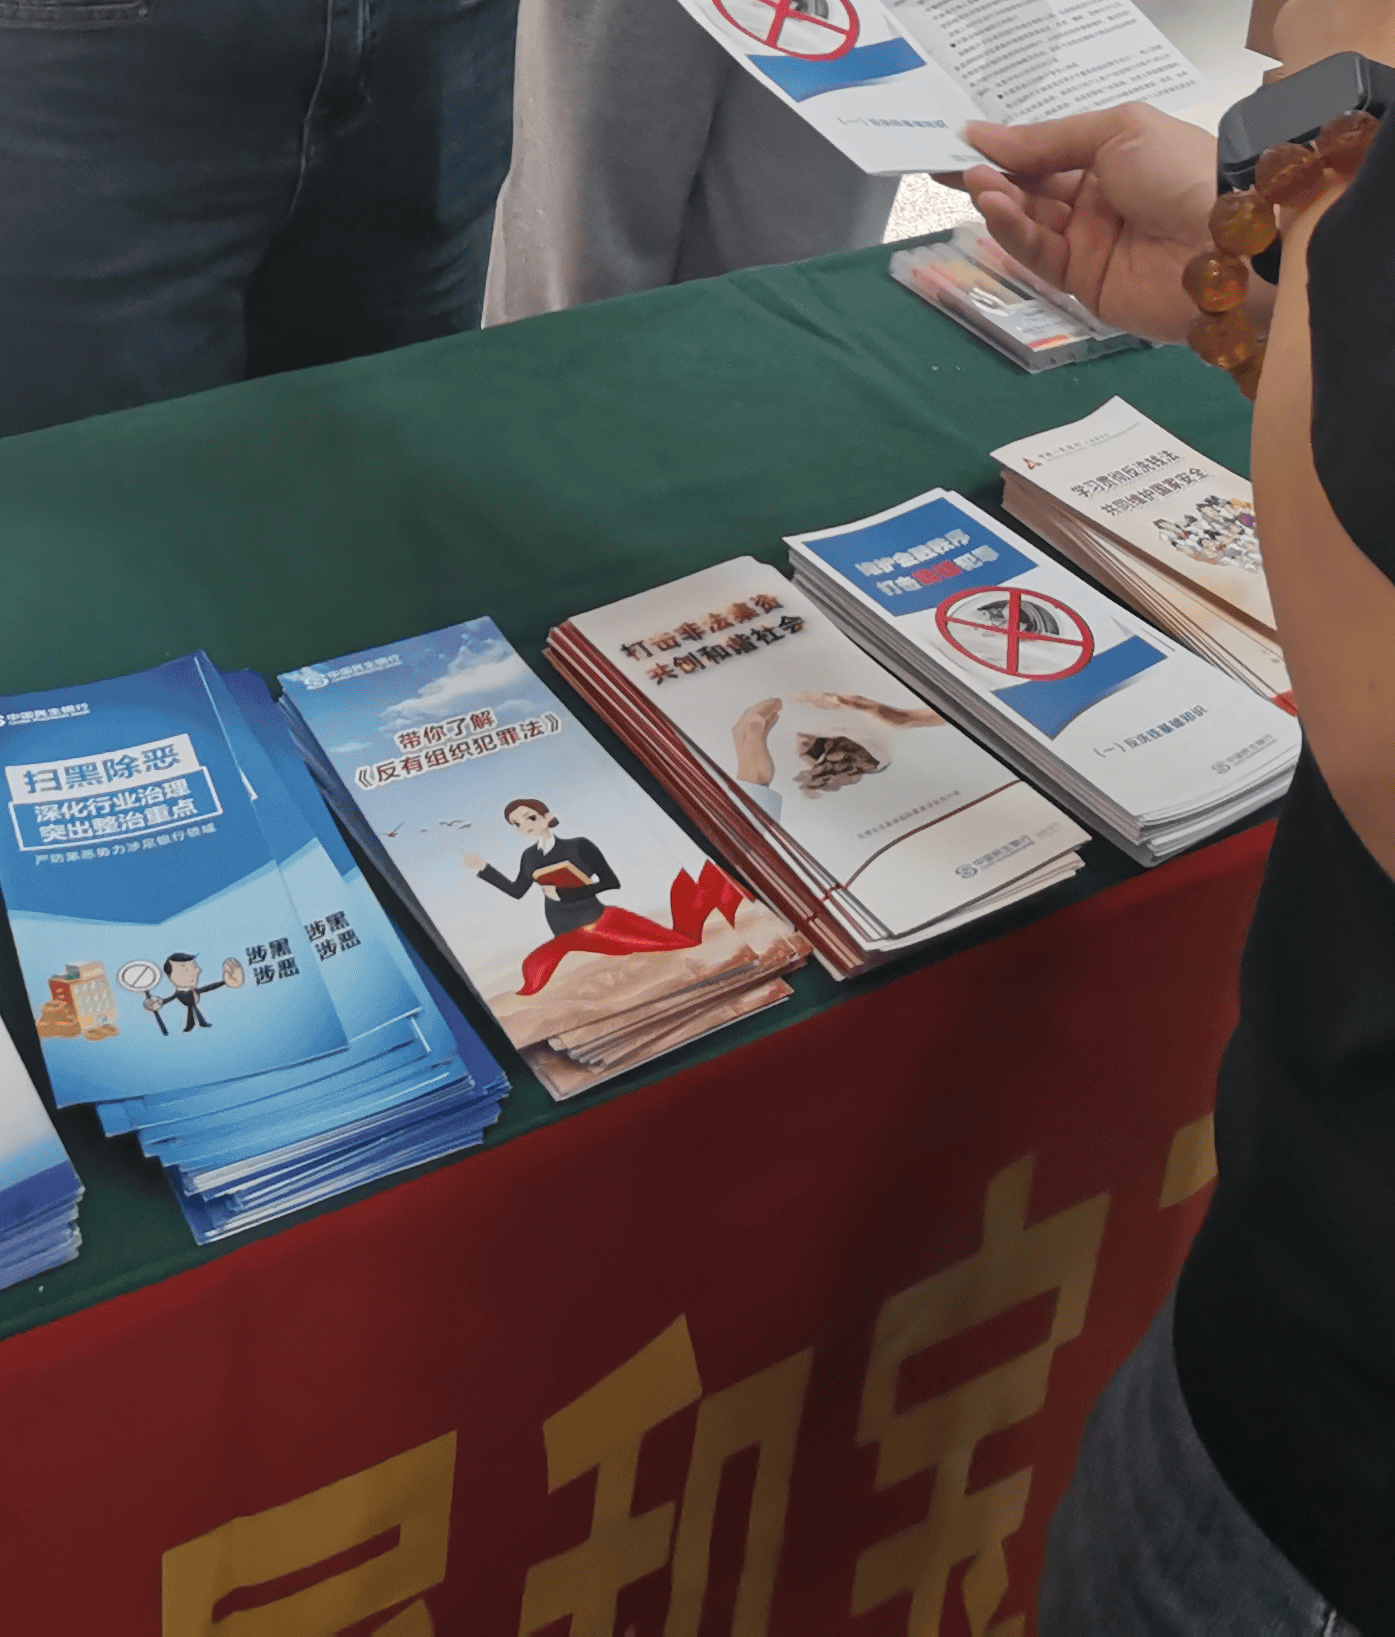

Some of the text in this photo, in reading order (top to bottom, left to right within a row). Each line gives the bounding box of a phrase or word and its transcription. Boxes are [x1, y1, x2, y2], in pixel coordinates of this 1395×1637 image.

[357, 713, 560, 789] 《反有组织犯罪法》
[398, 709, 495, 751] 带你了解
[23, 743, 182, 795] 扫黑除恶
[34, 777, 192, 823] 深化行业治理
[39, 798, 199, 843] 突出整治重点
[245, 937, 292, 966] 涉黑
[252, 956, 300, 986] 涉恶
